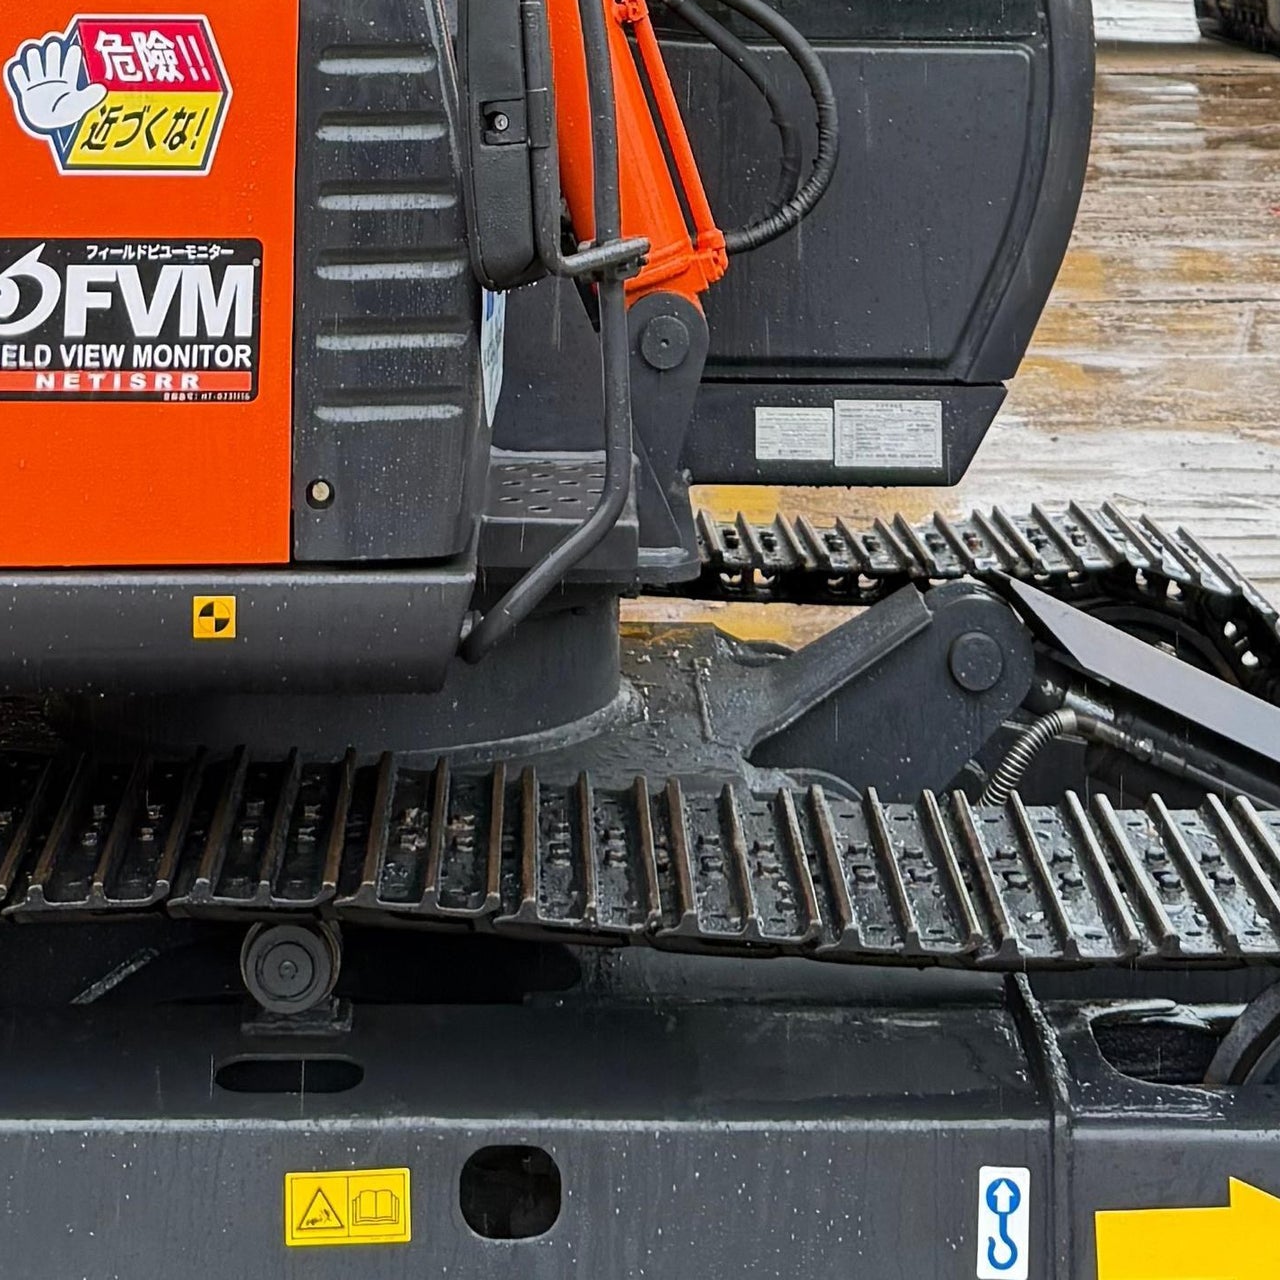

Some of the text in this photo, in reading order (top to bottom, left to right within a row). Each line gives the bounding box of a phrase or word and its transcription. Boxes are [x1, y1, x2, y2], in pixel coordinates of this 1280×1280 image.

[64, 265, 255, 337] FVM
[60, 344, 125, 368] VIEW
[132, 344, 252, 368] MONITOR
